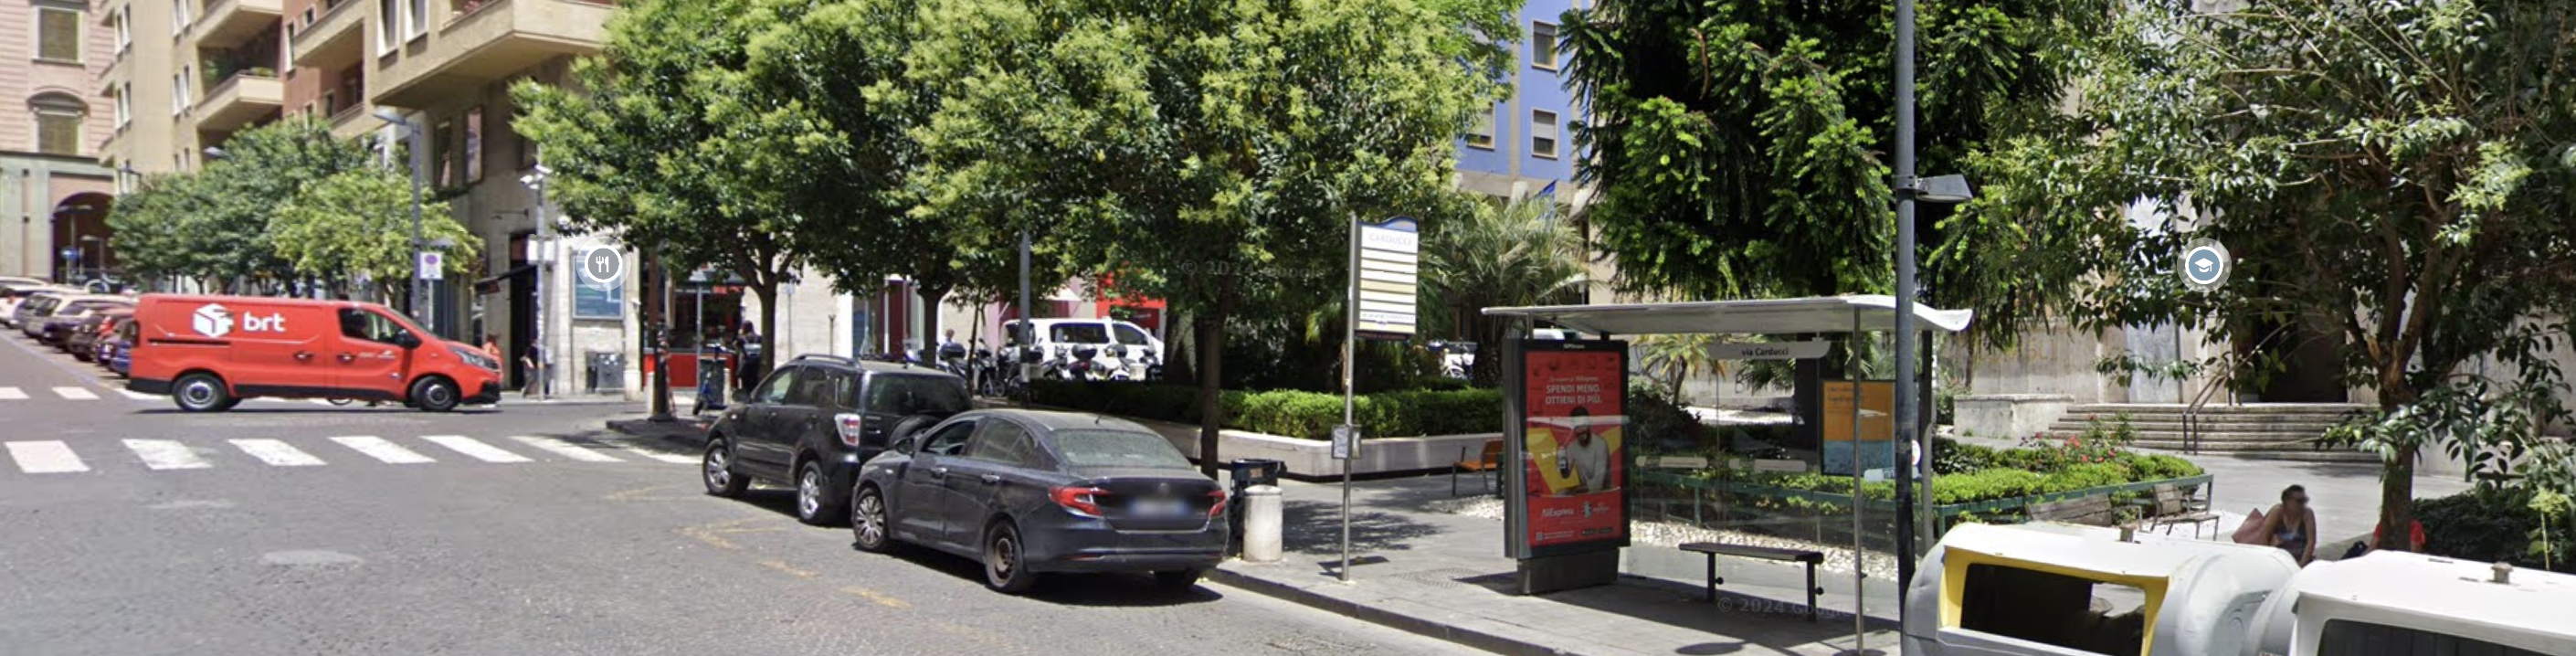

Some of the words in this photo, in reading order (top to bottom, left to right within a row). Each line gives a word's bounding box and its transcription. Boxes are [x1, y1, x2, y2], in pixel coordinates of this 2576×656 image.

[1369, 233, 1412, 247] CARDUCCI
[243, 311, 286, 332] brt
[1741, 347, 1753, 355] via
[1755, 347, 1789, 355] Carducci
[1546, 385, 1575, 394] SPENDI
[1545, 396, 1576, 405] OTTIENI
